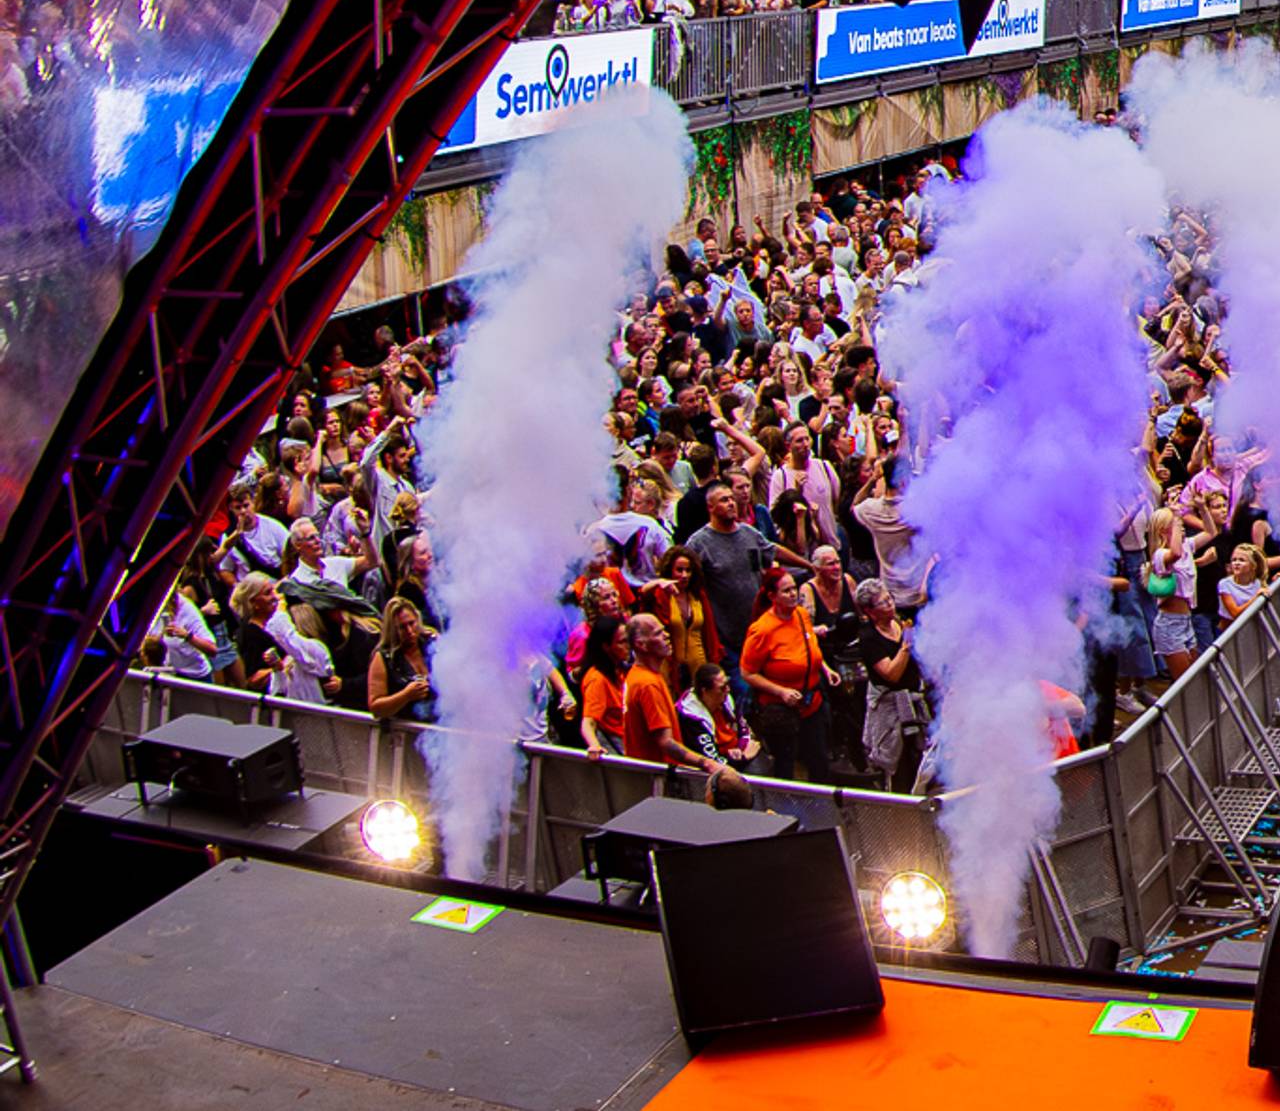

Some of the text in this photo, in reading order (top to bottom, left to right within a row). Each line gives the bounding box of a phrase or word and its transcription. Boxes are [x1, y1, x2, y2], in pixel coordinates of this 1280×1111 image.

[848, 17, 957, 55] Van beats naar leads
